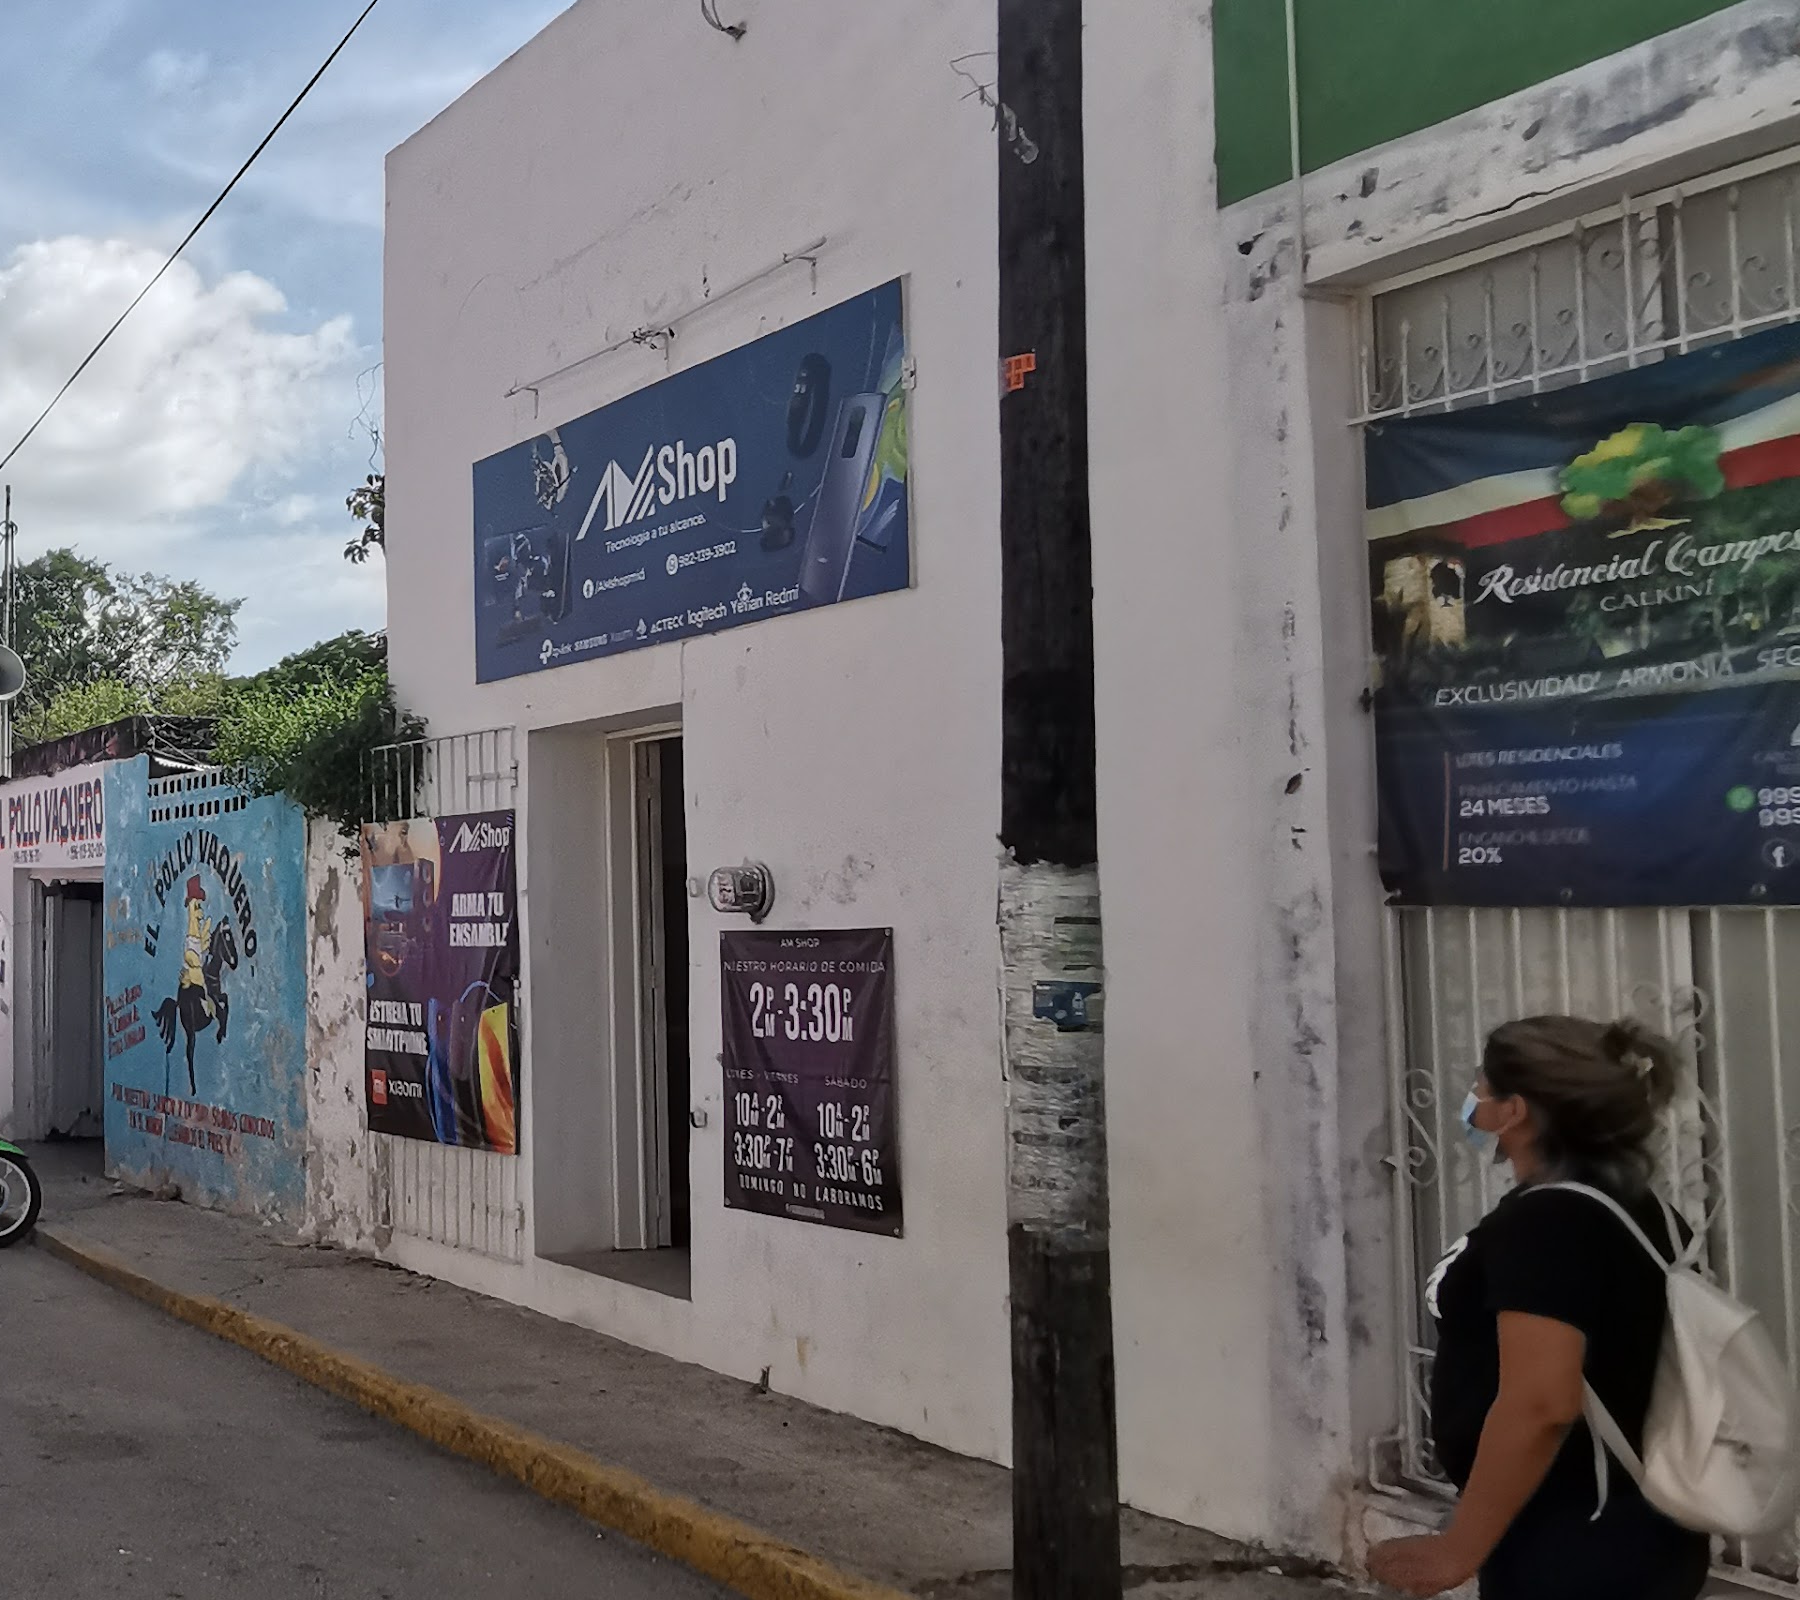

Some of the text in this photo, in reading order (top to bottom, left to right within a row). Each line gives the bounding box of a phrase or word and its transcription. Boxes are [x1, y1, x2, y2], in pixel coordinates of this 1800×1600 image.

[657, 437, 737, 504] Shop
[1473, 540, 1663, 604] Residencial
[687, 602, 727, 629] logitech
[1434, 672, 1600, 706] EXCLUSIVIDAD
[44, 778, 104, 848] VAQUERO
[1459, 796, 1550, 817] 24 MESES
[480, 822, 510, 853] Shop
[1458, 846, 1502, 865] 20%
[144, 828, 257, 958] EL POLLO VAQUERO
[487, 891, 504, 917] TU
[796, 938, 820, 948] SHOP
[770, 961, 818, 973] HORARIO
[821, 961, 835, 973] DE
[838, 961, 886, 974] COMIDA
[738, 1173, 784, 1195] DOMINGO
[793, 1182, 806, 1199] NO
[815, 1186, 884, 1211] LABORAMOS
